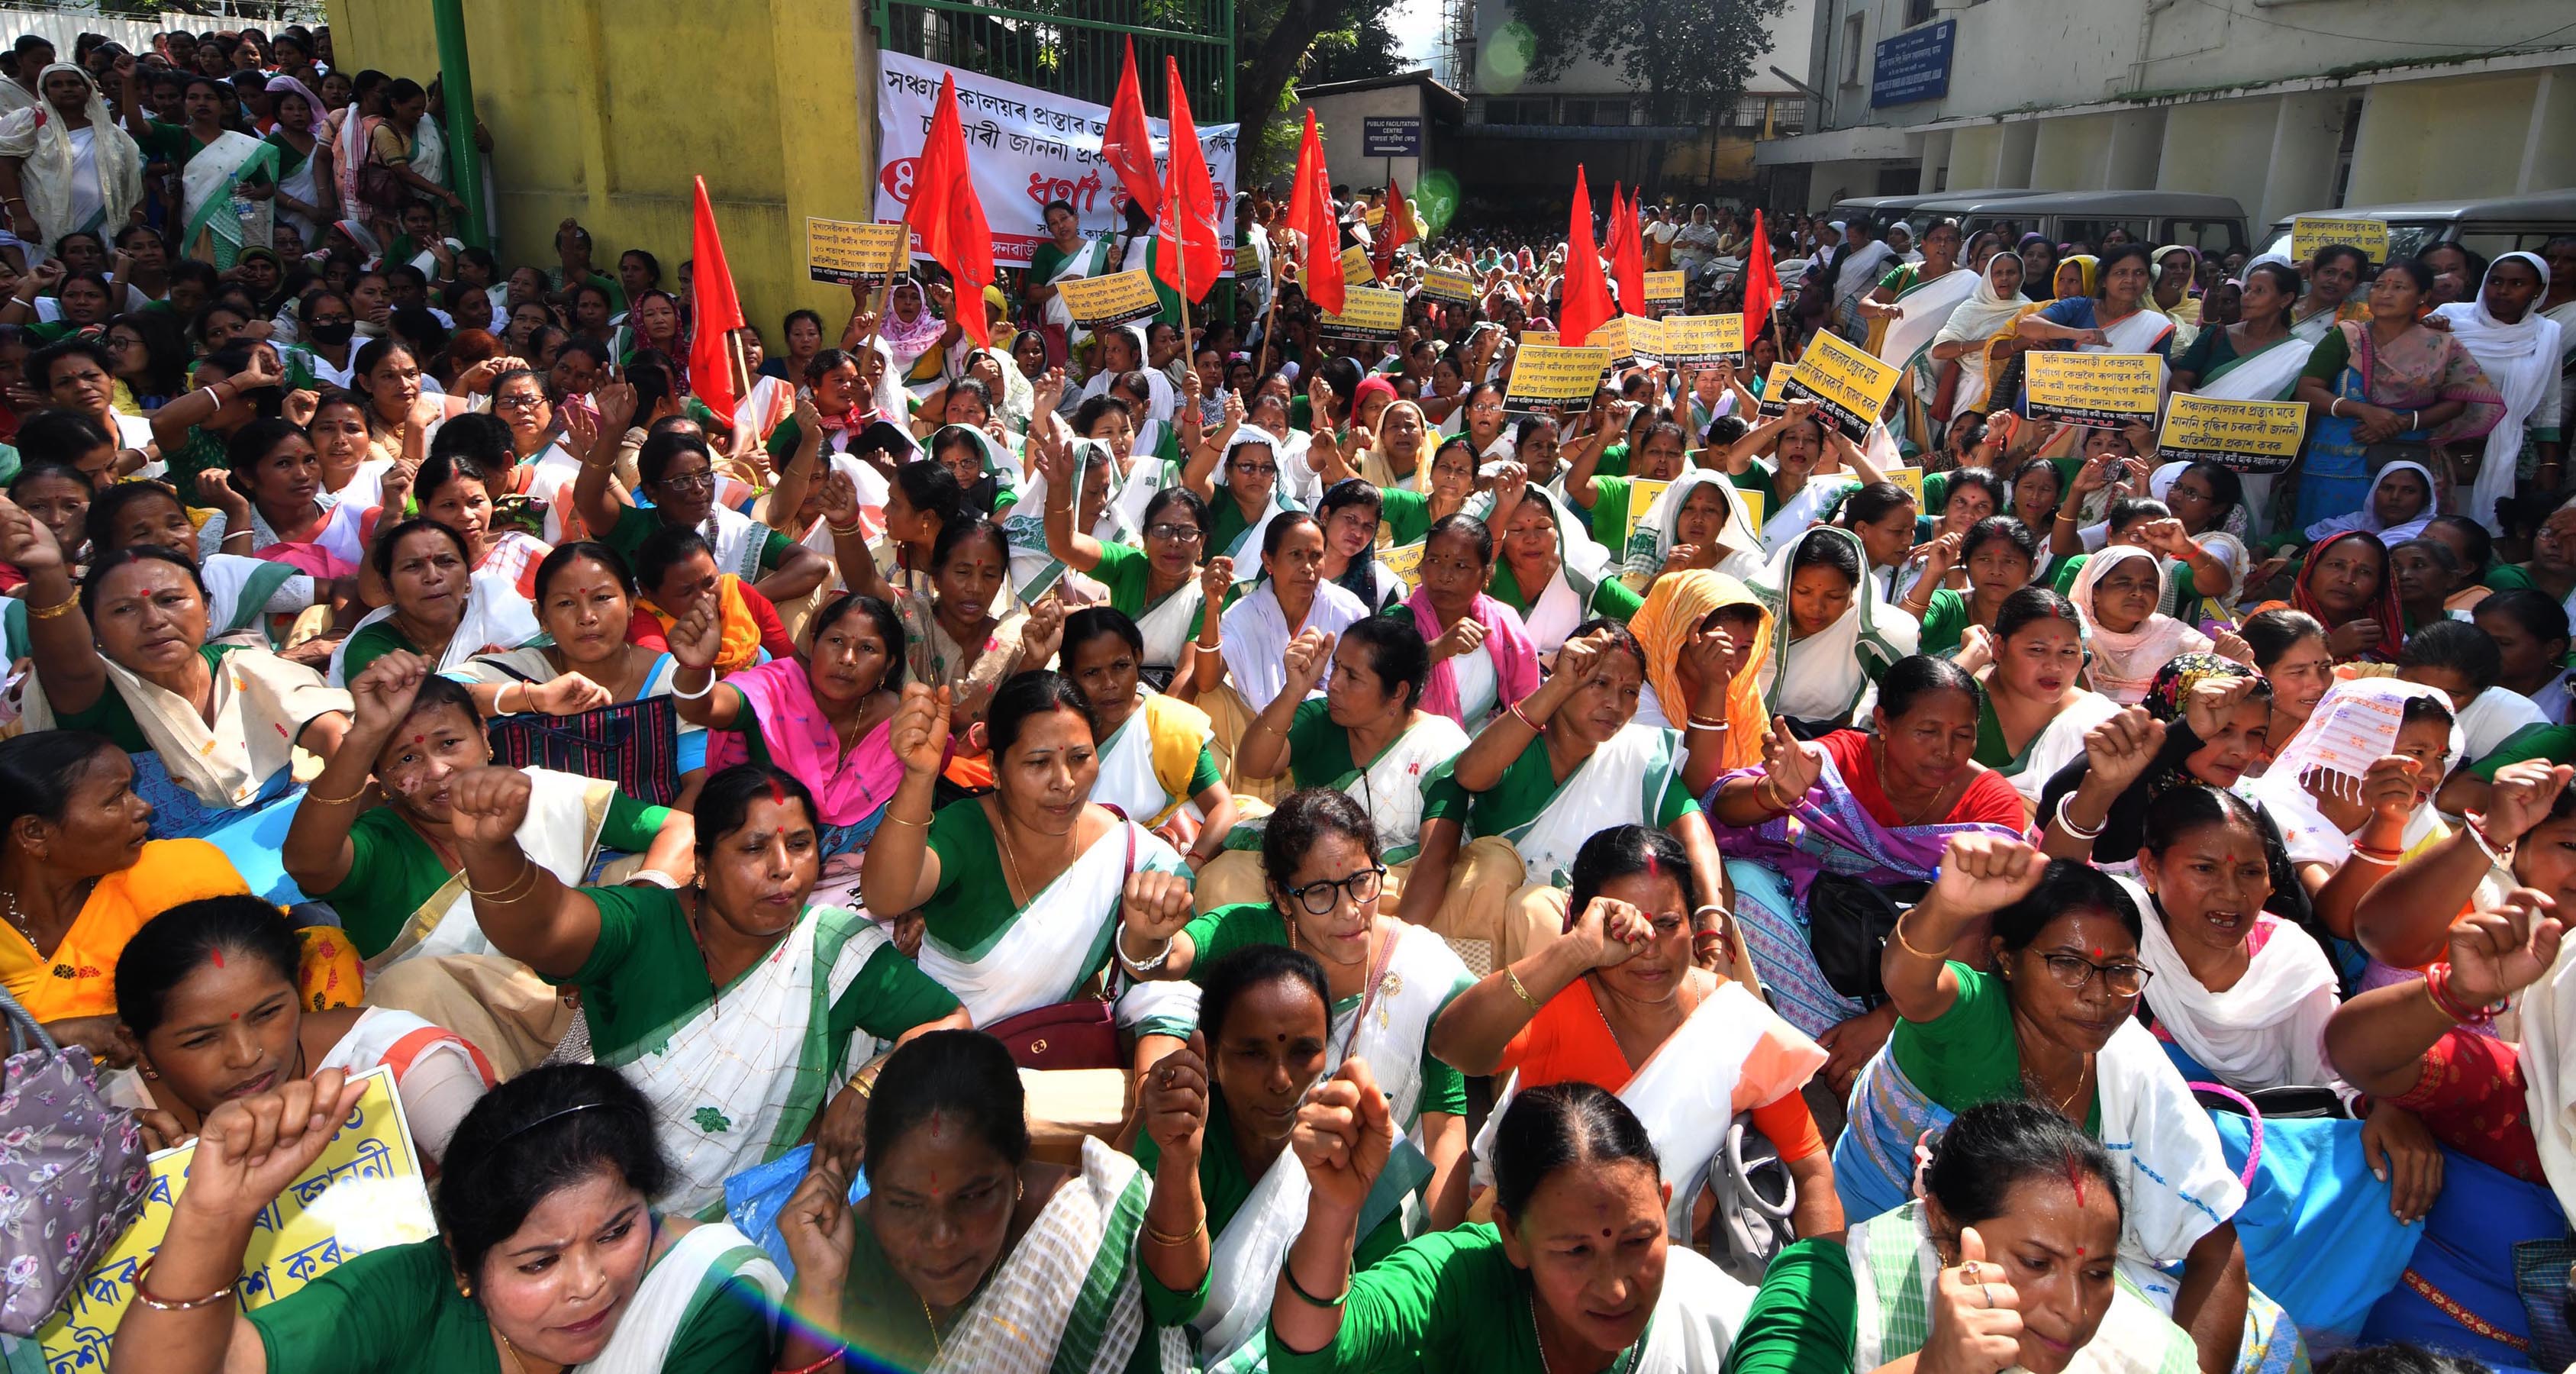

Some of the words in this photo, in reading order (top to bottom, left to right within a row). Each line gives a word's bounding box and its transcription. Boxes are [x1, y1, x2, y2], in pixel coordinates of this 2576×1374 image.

[886, 70, 1027, 121] সঞ্চাকালয়ৰ
[991, 240, 1039, 260] ঙ্গনৱাড়ী
[2042, 353, 2059, 364] মিনি
[2060, 415, 2114, 427] CITU
[2276, 408, 2297, 418] মতে
[280, 1236, 363, 1282] কৰ
